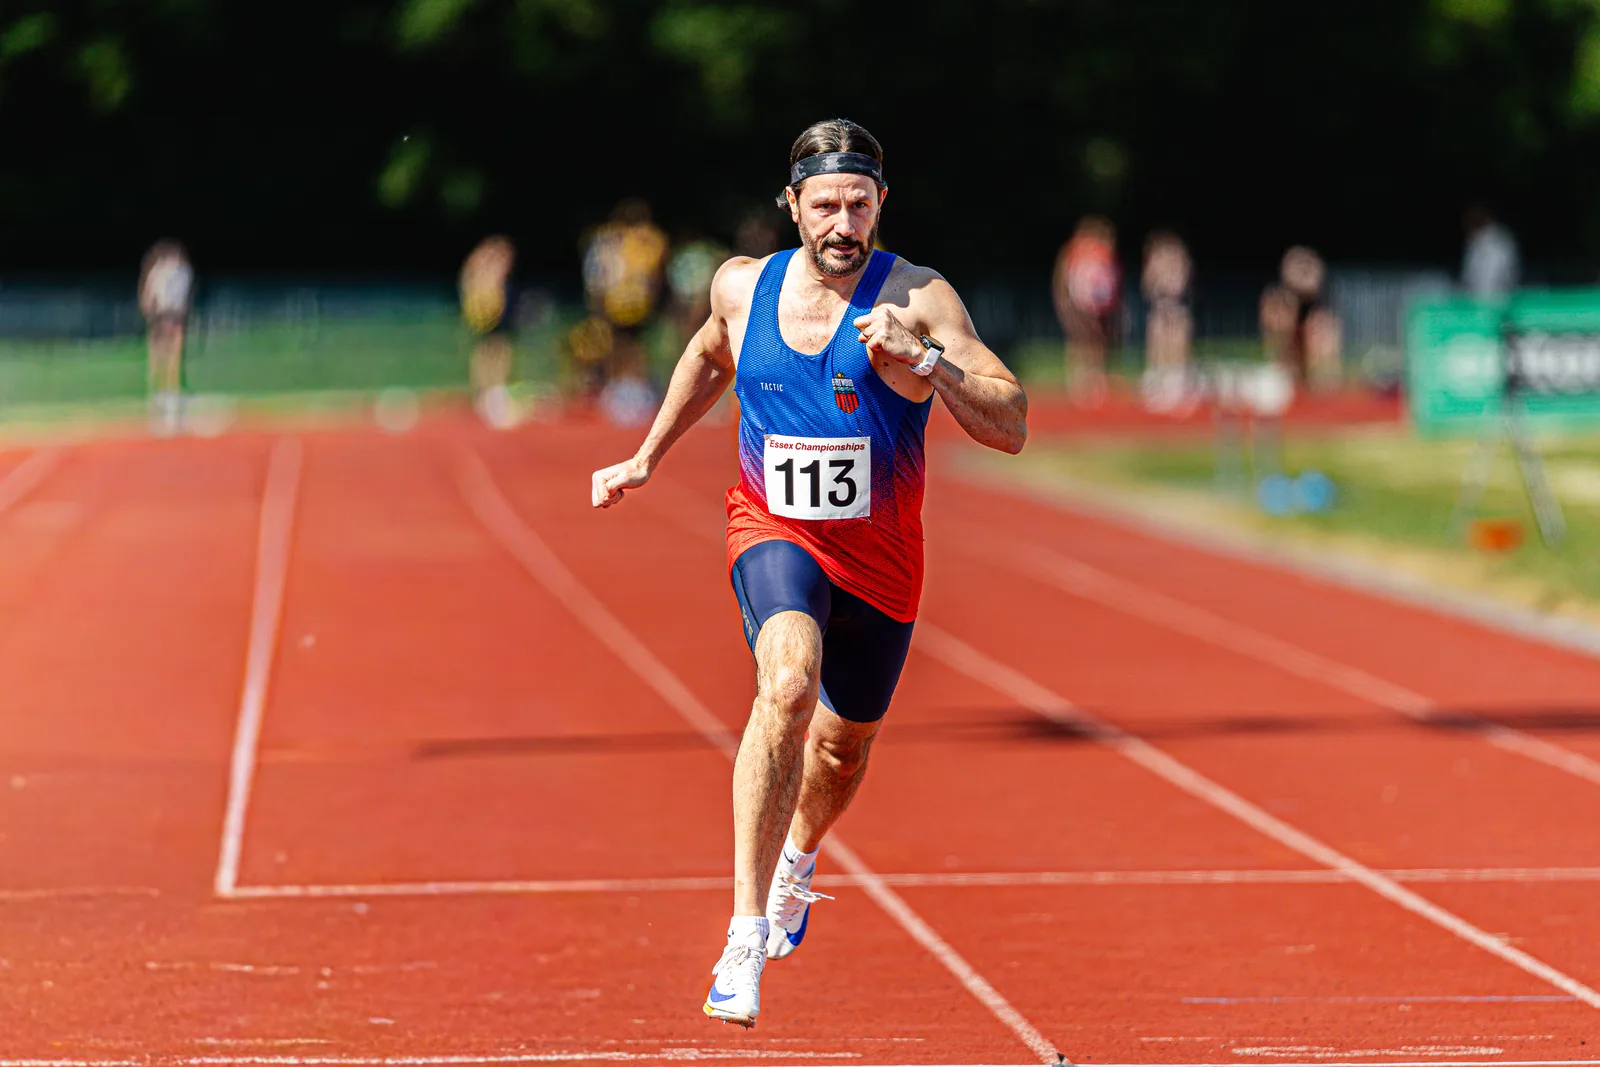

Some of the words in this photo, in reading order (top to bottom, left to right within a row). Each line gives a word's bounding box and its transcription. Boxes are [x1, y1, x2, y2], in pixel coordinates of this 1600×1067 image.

[760, 382, 784, 392] TACTIC
[769, 440, 794, 450] Essex
[795, 442, 866, 453] Championships
[775, 458, 857, 507] 113
